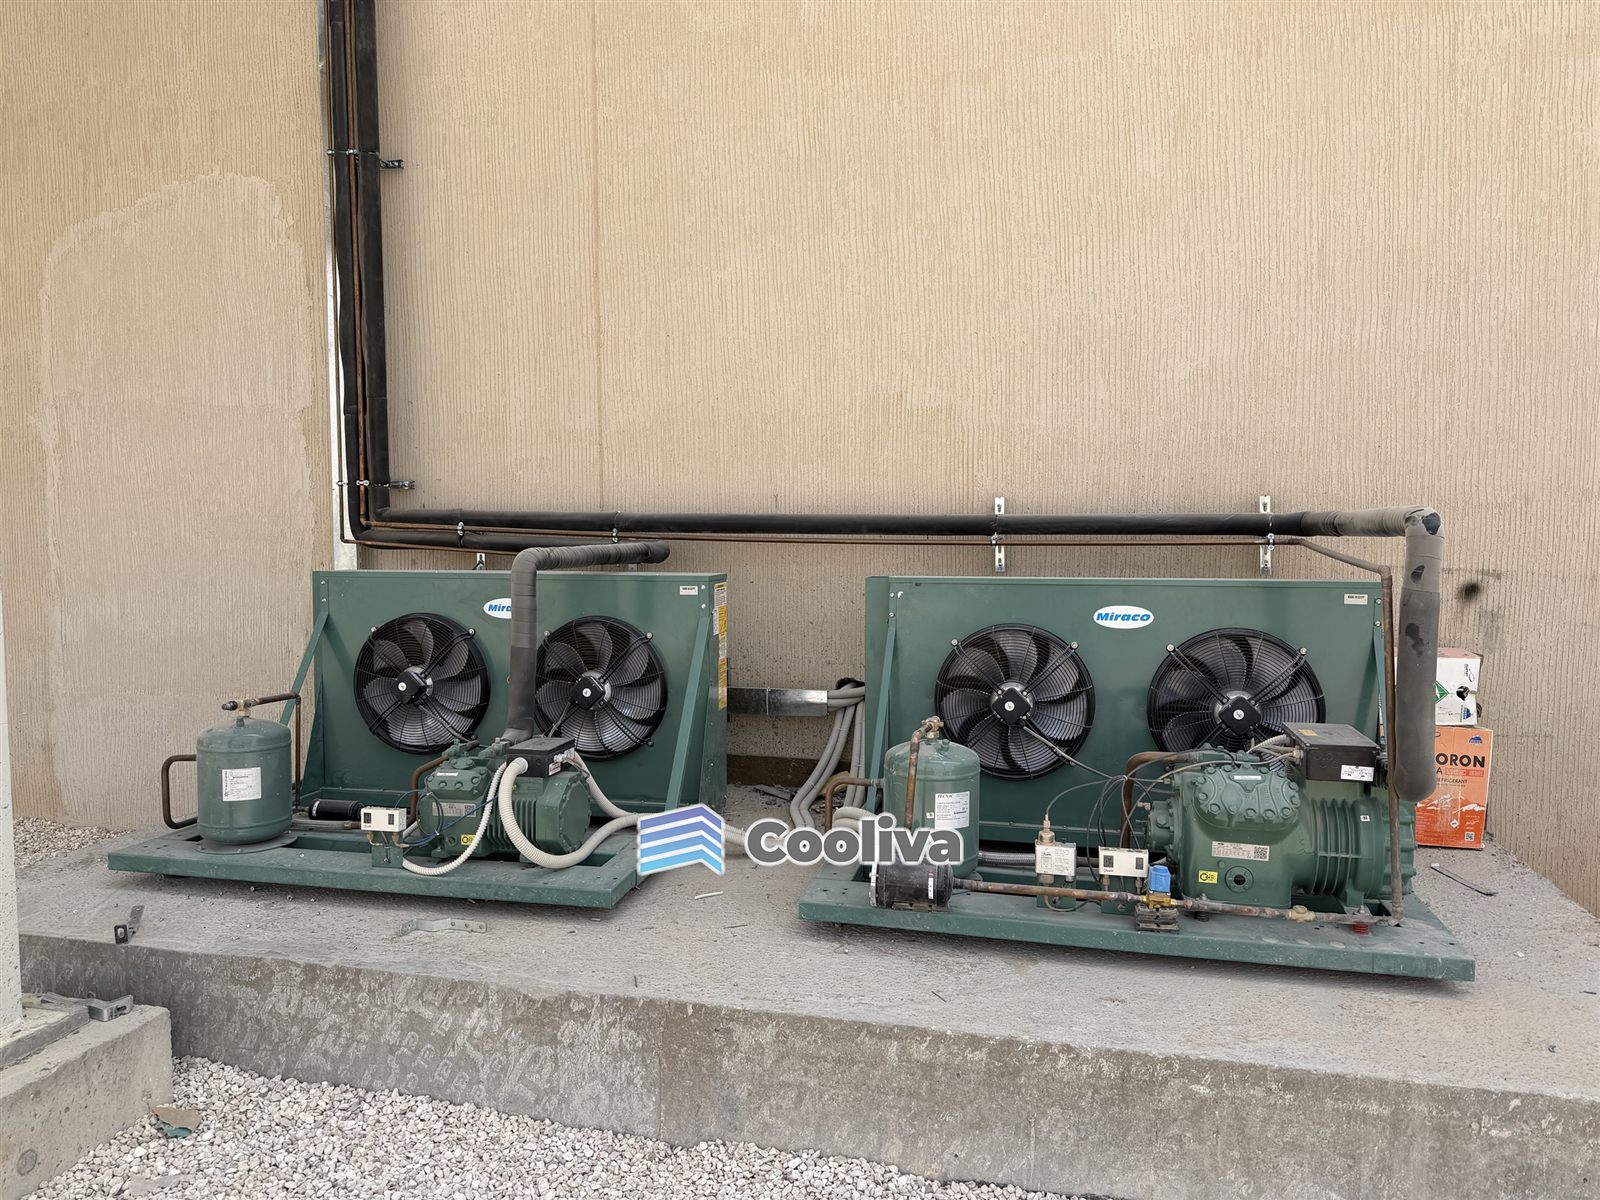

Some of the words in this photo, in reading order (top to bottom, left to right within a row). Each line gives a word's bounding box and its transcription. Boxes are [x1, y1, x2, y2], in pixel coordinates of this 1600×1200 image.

[488, 604, 512, 612] Mira
[1096, 612, 1151, 622] Miraco
[1435, 752, 1486, 769] ORON
